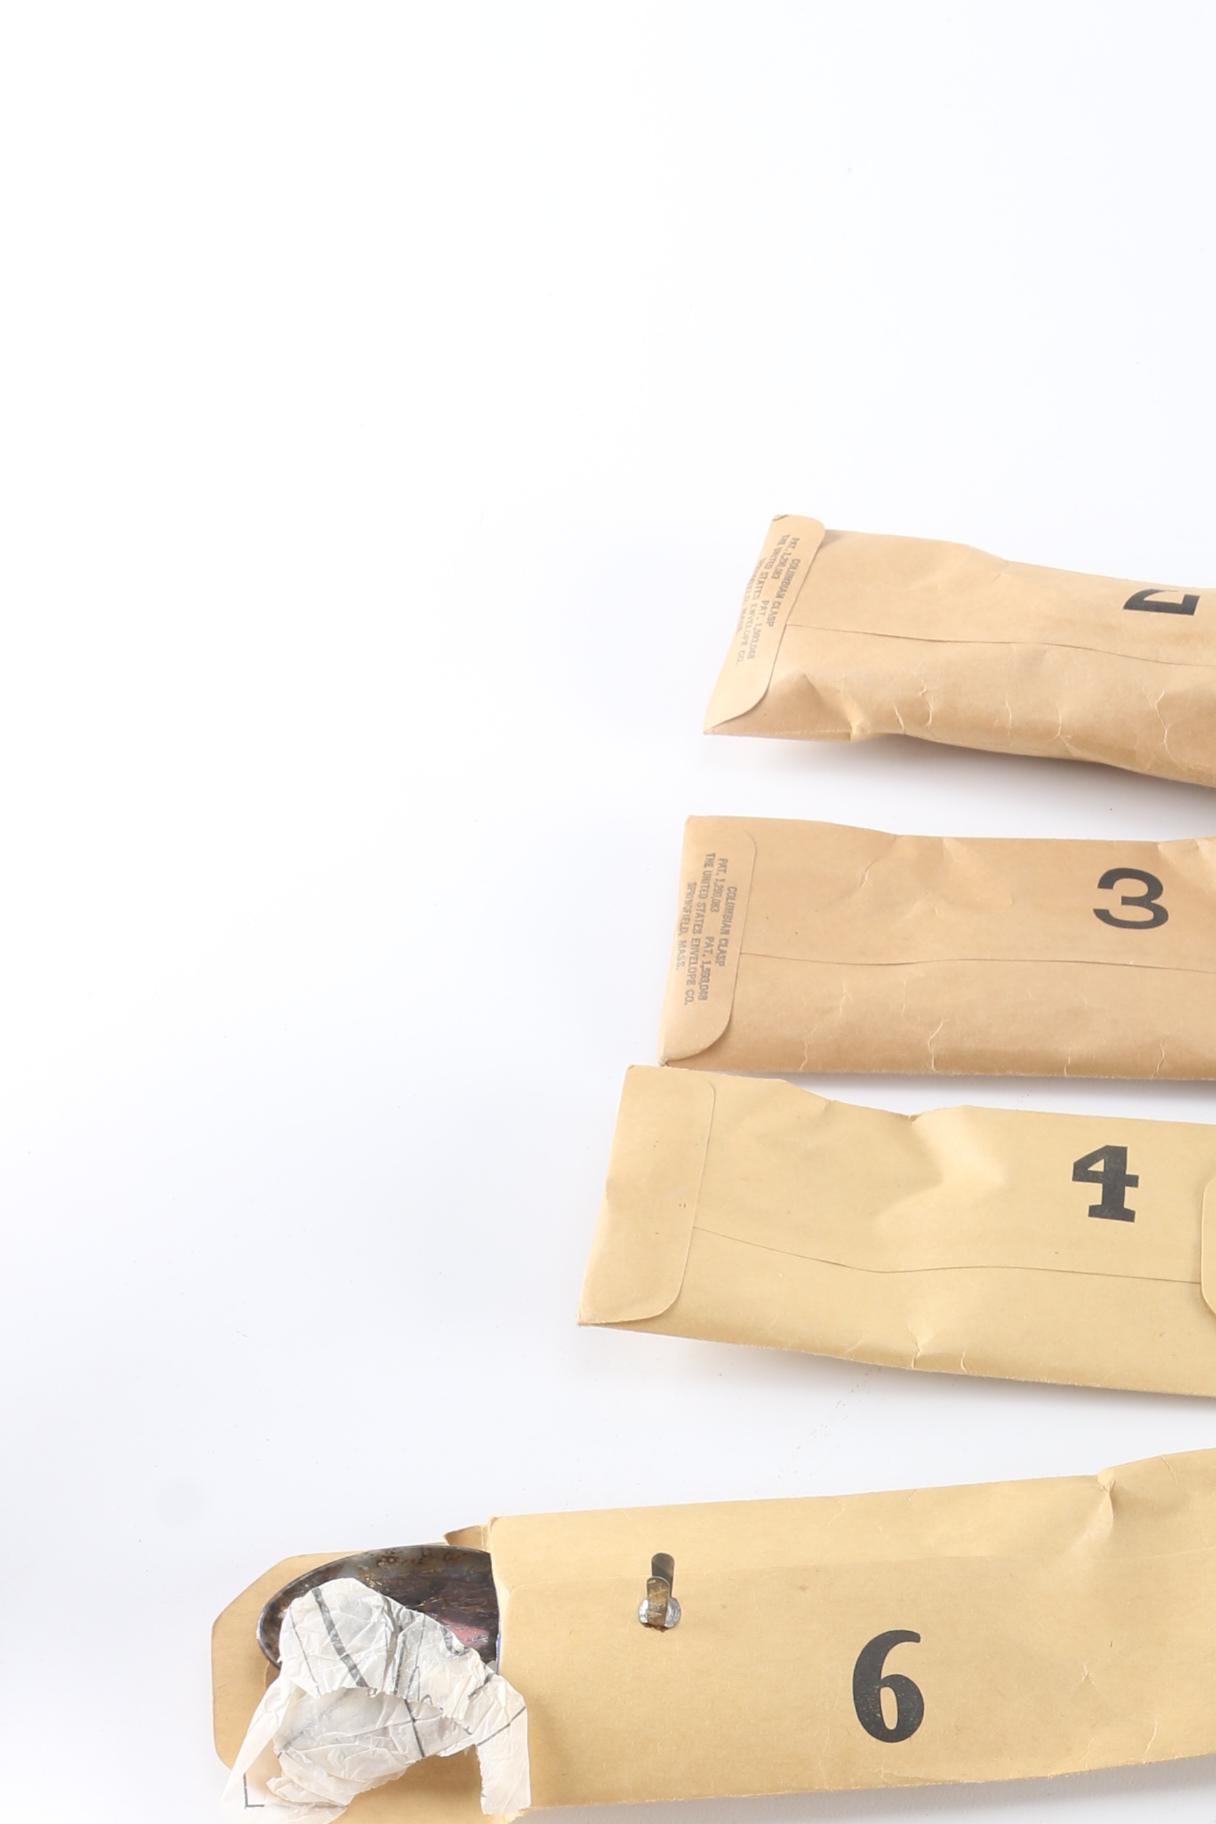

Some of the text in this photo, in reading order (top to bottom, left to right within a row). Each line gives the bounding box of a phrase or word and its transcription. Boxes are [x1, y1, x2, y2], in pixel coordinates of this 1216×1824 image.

[716, 857, 729, 876] PAT.
[1093, 867, 1169, 930] 3
[684, 852, 716, 1006] THE UNITED STATES ENVELOPE CO.
[702, 936, 714, 957] PAT.
[715, 886, 738, 967] COLUMBIAN CLASP
[1072, 1145, 1139, 1223] 4
[852, 1629, 925, 1743] 6
